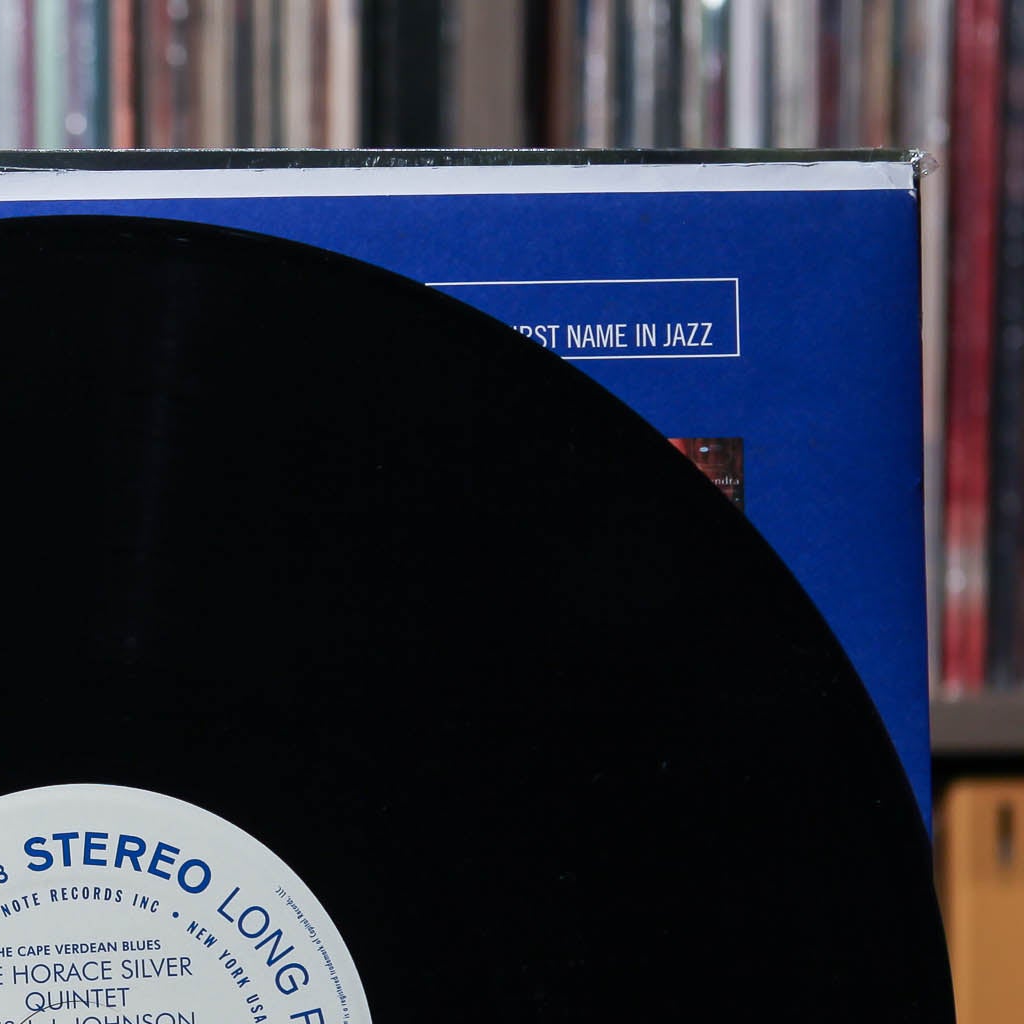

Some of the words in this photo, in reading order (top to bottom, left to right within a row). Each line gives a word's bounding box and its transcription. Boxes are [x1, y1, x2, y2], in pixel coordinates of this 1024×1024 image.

[567, 324, 627, 348] NAME
[636, 323, 656, 347] IN
[663, 323, 712, 347] JAZZ
[23, 831, 212, 894] STEREO
[217, 887, 310, 995] LONG
[1, 892, 41, 918] NOTE
[51, 886, 123, 903] RECORDS
[133, 894, 160, 913] INC
[186, 920, 218, 948] NEW
[218, 949, 251, 988] YORK
[246, 994, 267, 1024] USA
[17, 945, 52, 957] CAPE
[55, 942, 118, 955] VERDEAN
[122, 939, 161, 951] BLUES
[317, 945, 336, 976] trademark
[12, 961, 113, 985] HORACE
[121, 957, 193, 979] SILVER
[25, 987, 130, 1012] QUINTET
[331, 975, 347, 1006] registered
